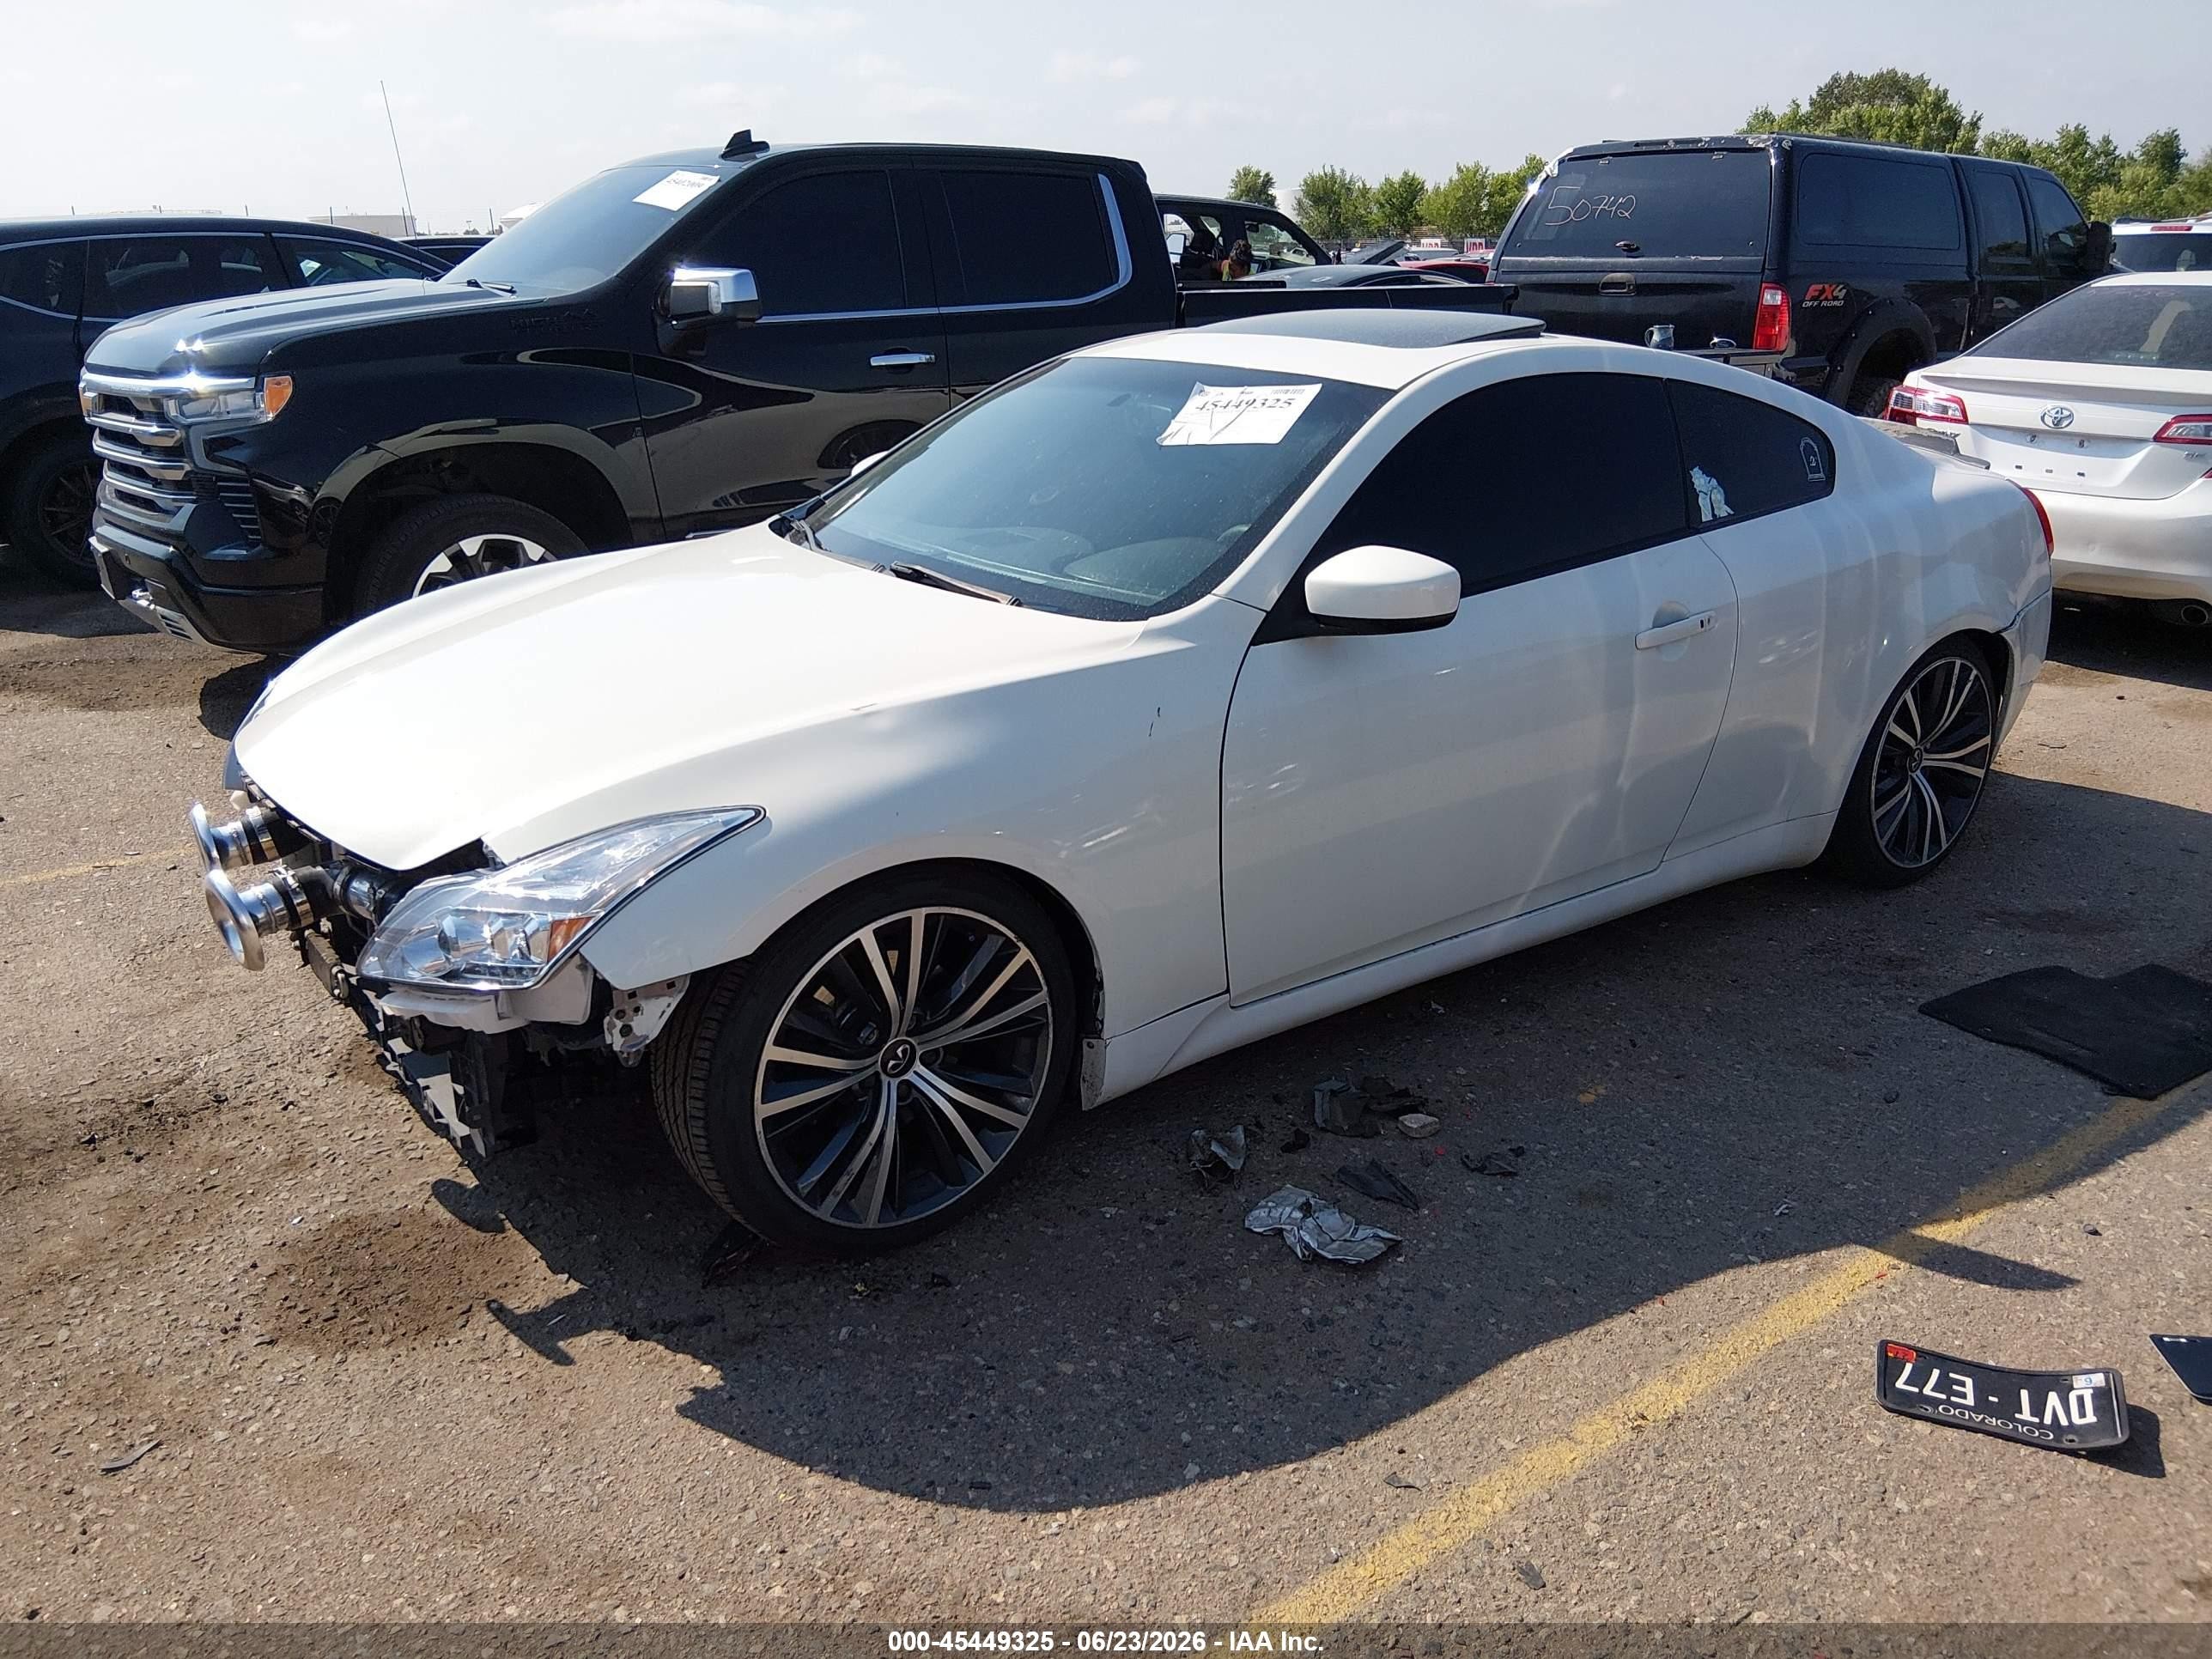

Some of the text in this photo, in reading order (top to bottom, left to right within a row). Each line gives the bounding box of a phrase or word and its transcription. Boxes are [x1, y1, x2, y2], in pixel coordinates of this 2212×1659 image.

[1545, 185, 1636, 225] 50742
[1805, 284, 1846, 300] FX4
[1195, 398, 1296, 410] 45449325
[1895, 1363, 1974, 1406] E77
[1937, 1405, 2053, 1440] COLORADO
[2014, 1389, 2098, 1425] DVT
